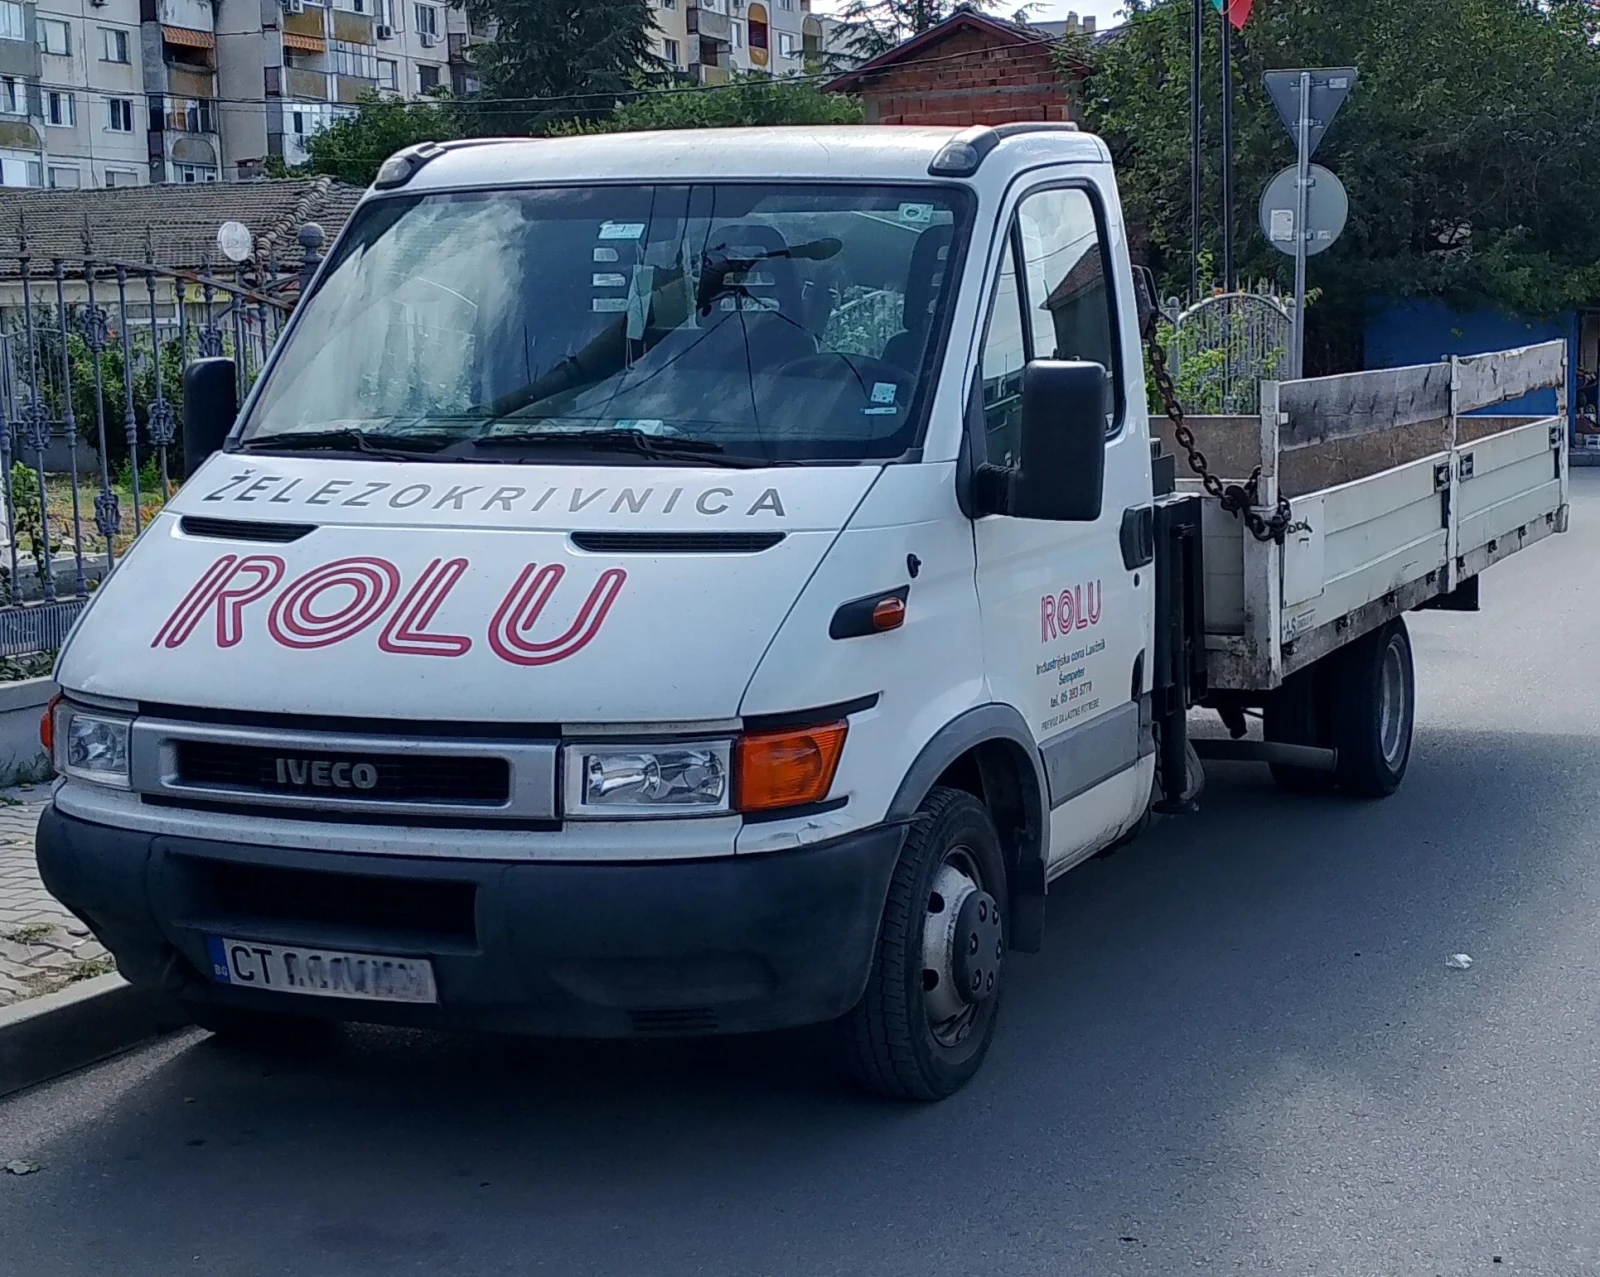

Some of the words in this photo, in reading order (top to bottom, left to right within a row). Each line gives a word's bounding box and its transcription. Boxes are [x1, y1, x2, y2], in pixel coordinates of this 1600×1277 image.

[203, 469, 787, 517] ŽELEZOKRIVNICA
[151, 554, 627, 666] ROLU
[1041, 579, 1101, 644] ROLU
[276, 758, 378, 789] IVECO
[214, 963, 228, 977] BG
